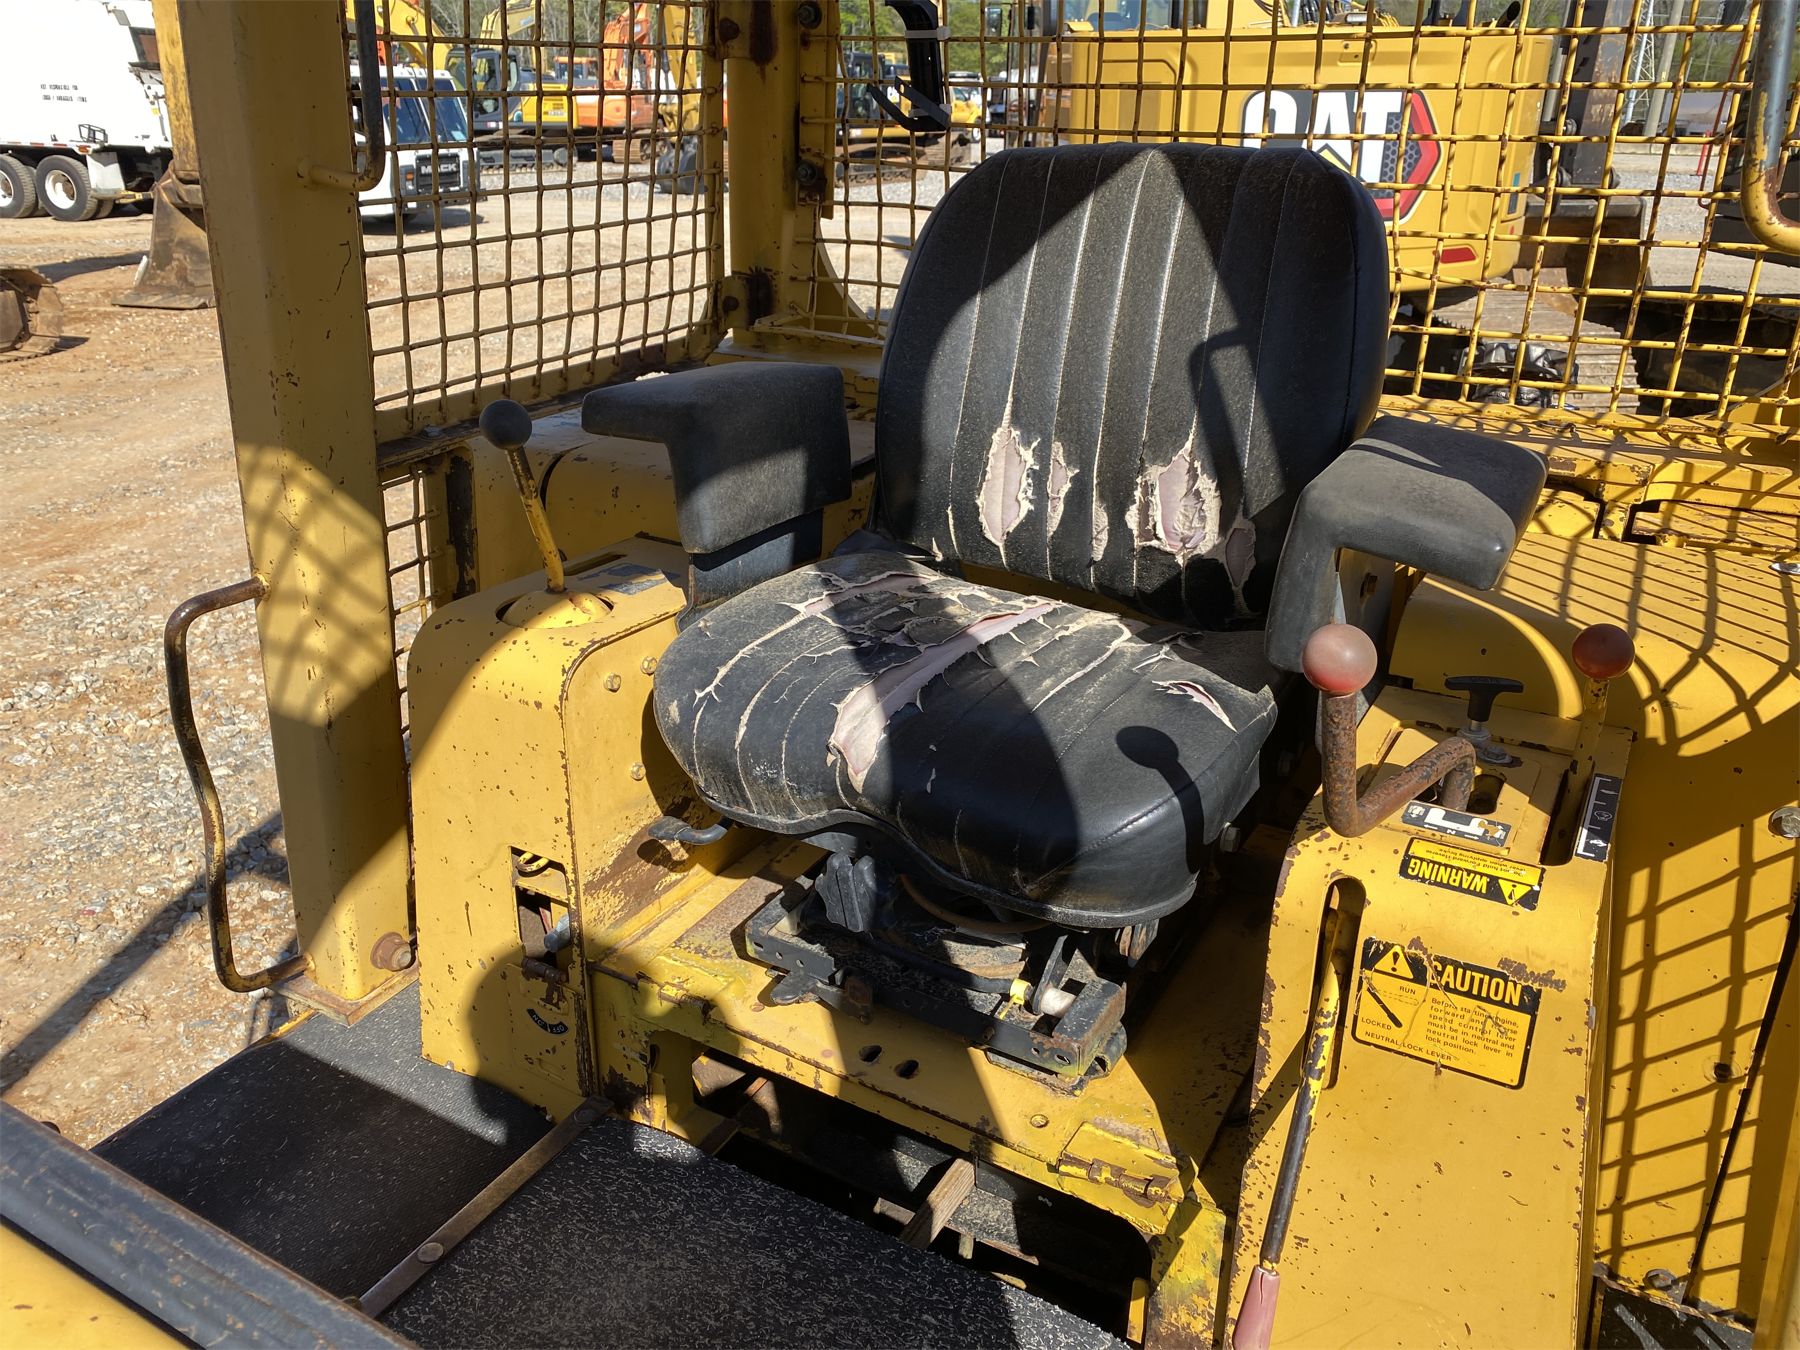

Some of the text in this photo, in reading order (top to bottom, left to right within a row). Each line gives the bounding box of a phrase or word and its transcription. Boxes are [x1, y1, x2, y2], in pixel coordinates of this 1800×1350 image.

[1243, 90, 1402, 182] CAT
[421, 163, 457, 174] MCK
[1407, 858, 1489, 894] WARNING
[1399, 985, 1416, 995] RUN
[1429, 960, 1522, 1007] CAUTION
[1430, 1005, 1465, 1020] forward
[1431, 997, 1457, 1009] Befor
[1361, 1016, 1392, 1031] LOCKED
[1429, 1013, 1454, 1025] speed
[1458, 1021, 1492, 1036] control
[1364, 1031, 1452, 1061] NEUTRAL LOCK LEVER
[1425, 1034, 1442, 1044] lock
[1426, 1028, 1459, 1041] neutral
[1462, 1037, 1479, 1048] lock
[1483, 1043, 1501, 1054] lever
[1427, 1021, 1447, 1031] must
[1449, 1026, 1459, 1034] be
[1471, 1033, 1499, 1046] neutral
[1500, 1041, 1516, 1051] and
